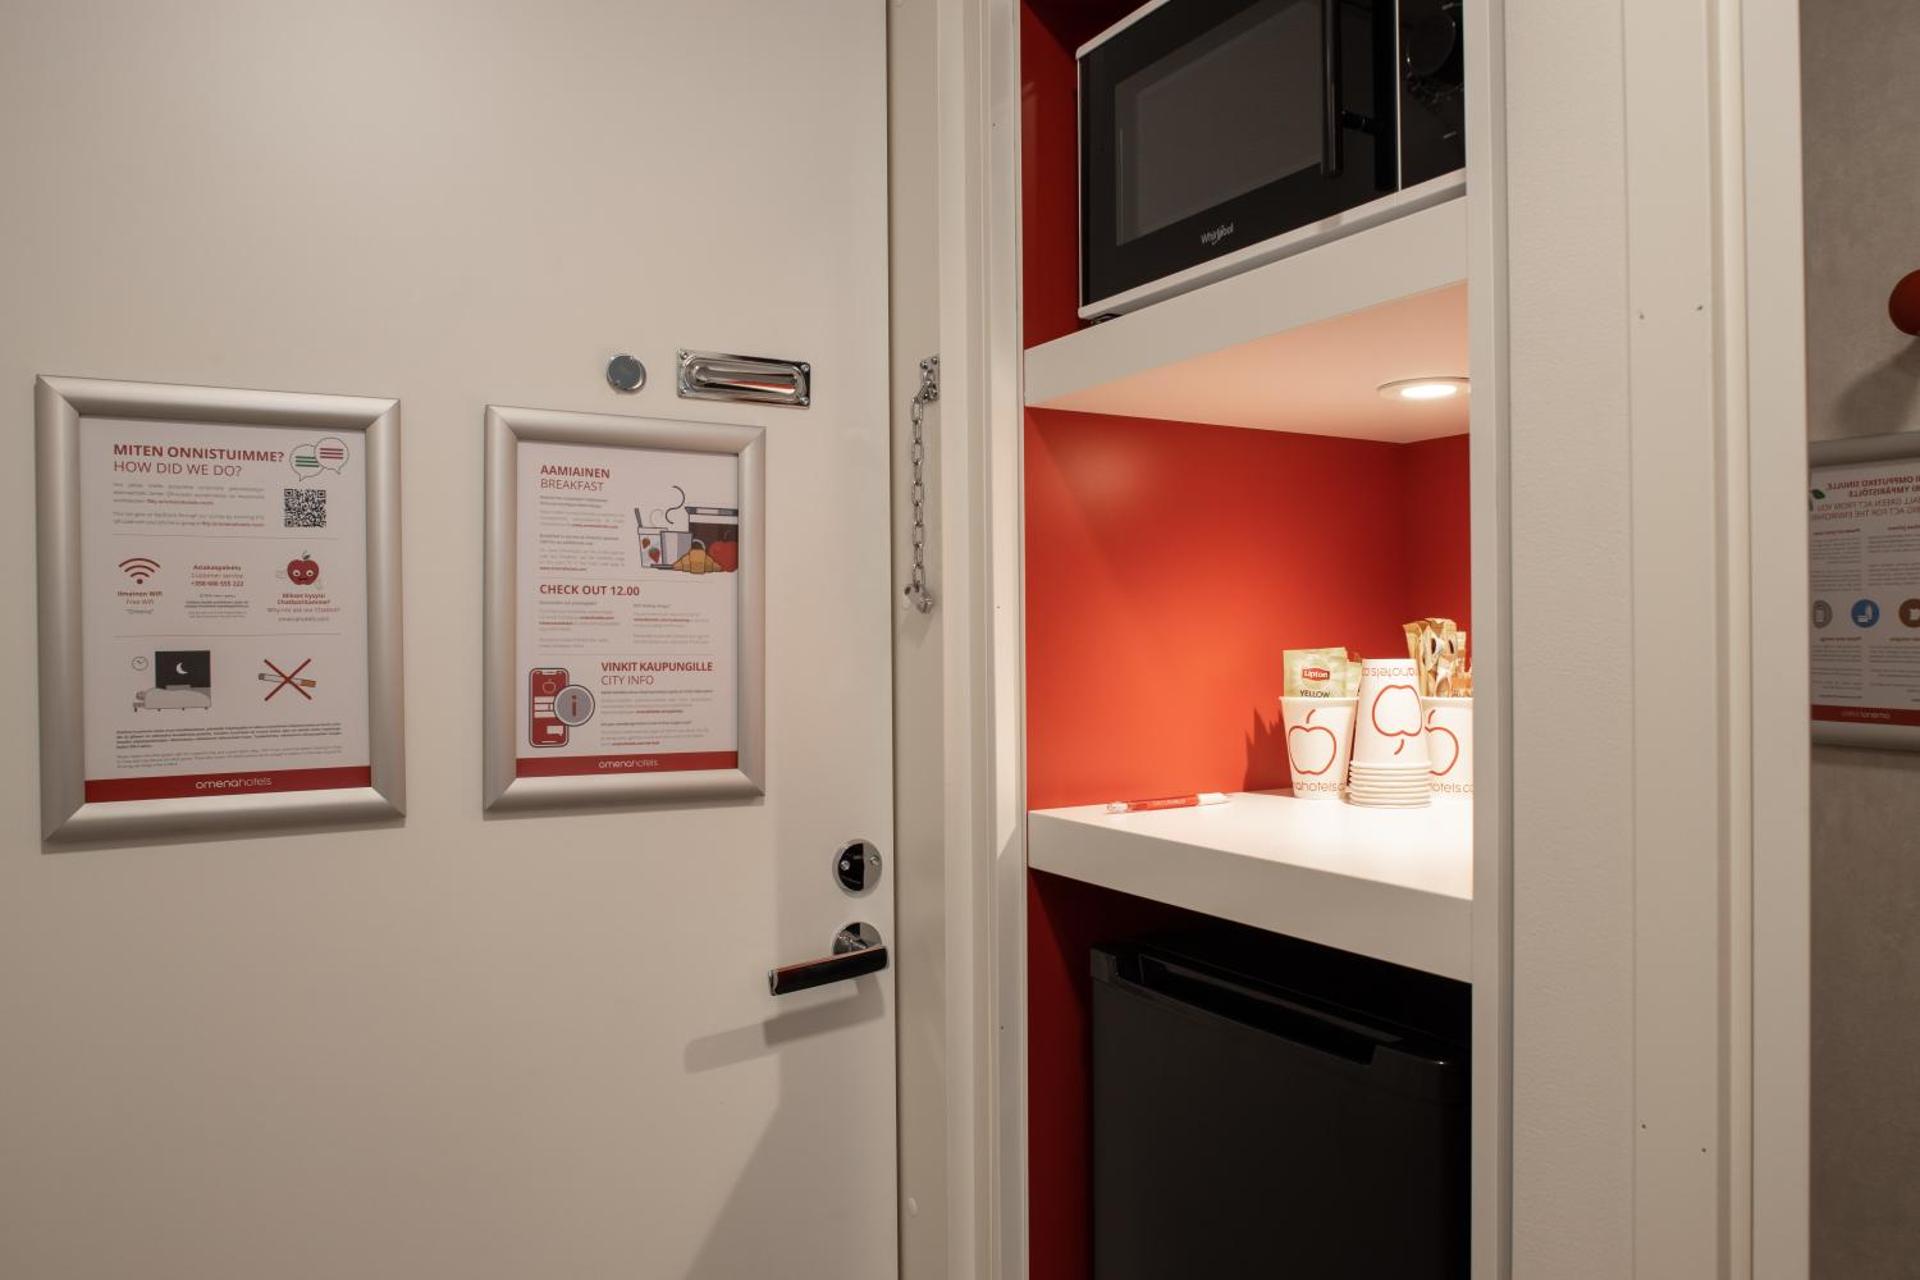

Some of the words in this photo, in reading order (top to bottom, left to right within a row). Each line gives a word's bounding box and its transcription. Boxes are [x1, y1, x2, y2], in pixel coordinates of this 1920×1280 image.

[1201, 222, 1234, 245] Whirlpool
[113, 443, 164, 458] MITEN
[167, 446, 285, 463] ONNISTUIMME?
[113, 461, 153, 473] HOW
[157, 462, 182, 475] DID
[187, 463, 210, 476] WE
[213, 464, 242, 478] DO?
[540, 465, 611, 480] AAMIAINEN
[540, 478, 604, 492] BREAKFAST
[540, 584, 578, 595] CHECK
[582, 585, 606, 596] OUT
[611, 586, 640, 597] 12.00
[601, 662, 637, 672] VINKIT
[639, 661, 714, 672] KAUPUNGILLE
[601, 674, 624, 686] CITY
[627, 674, 654, 686] INFO
[1302, 669, 1328, 681] Lipton
[1300, 690, 1331, 698] YELLOW
[599, 758, 658, 769] omenahotels
[195, 775, 272, 790] omenahotels
